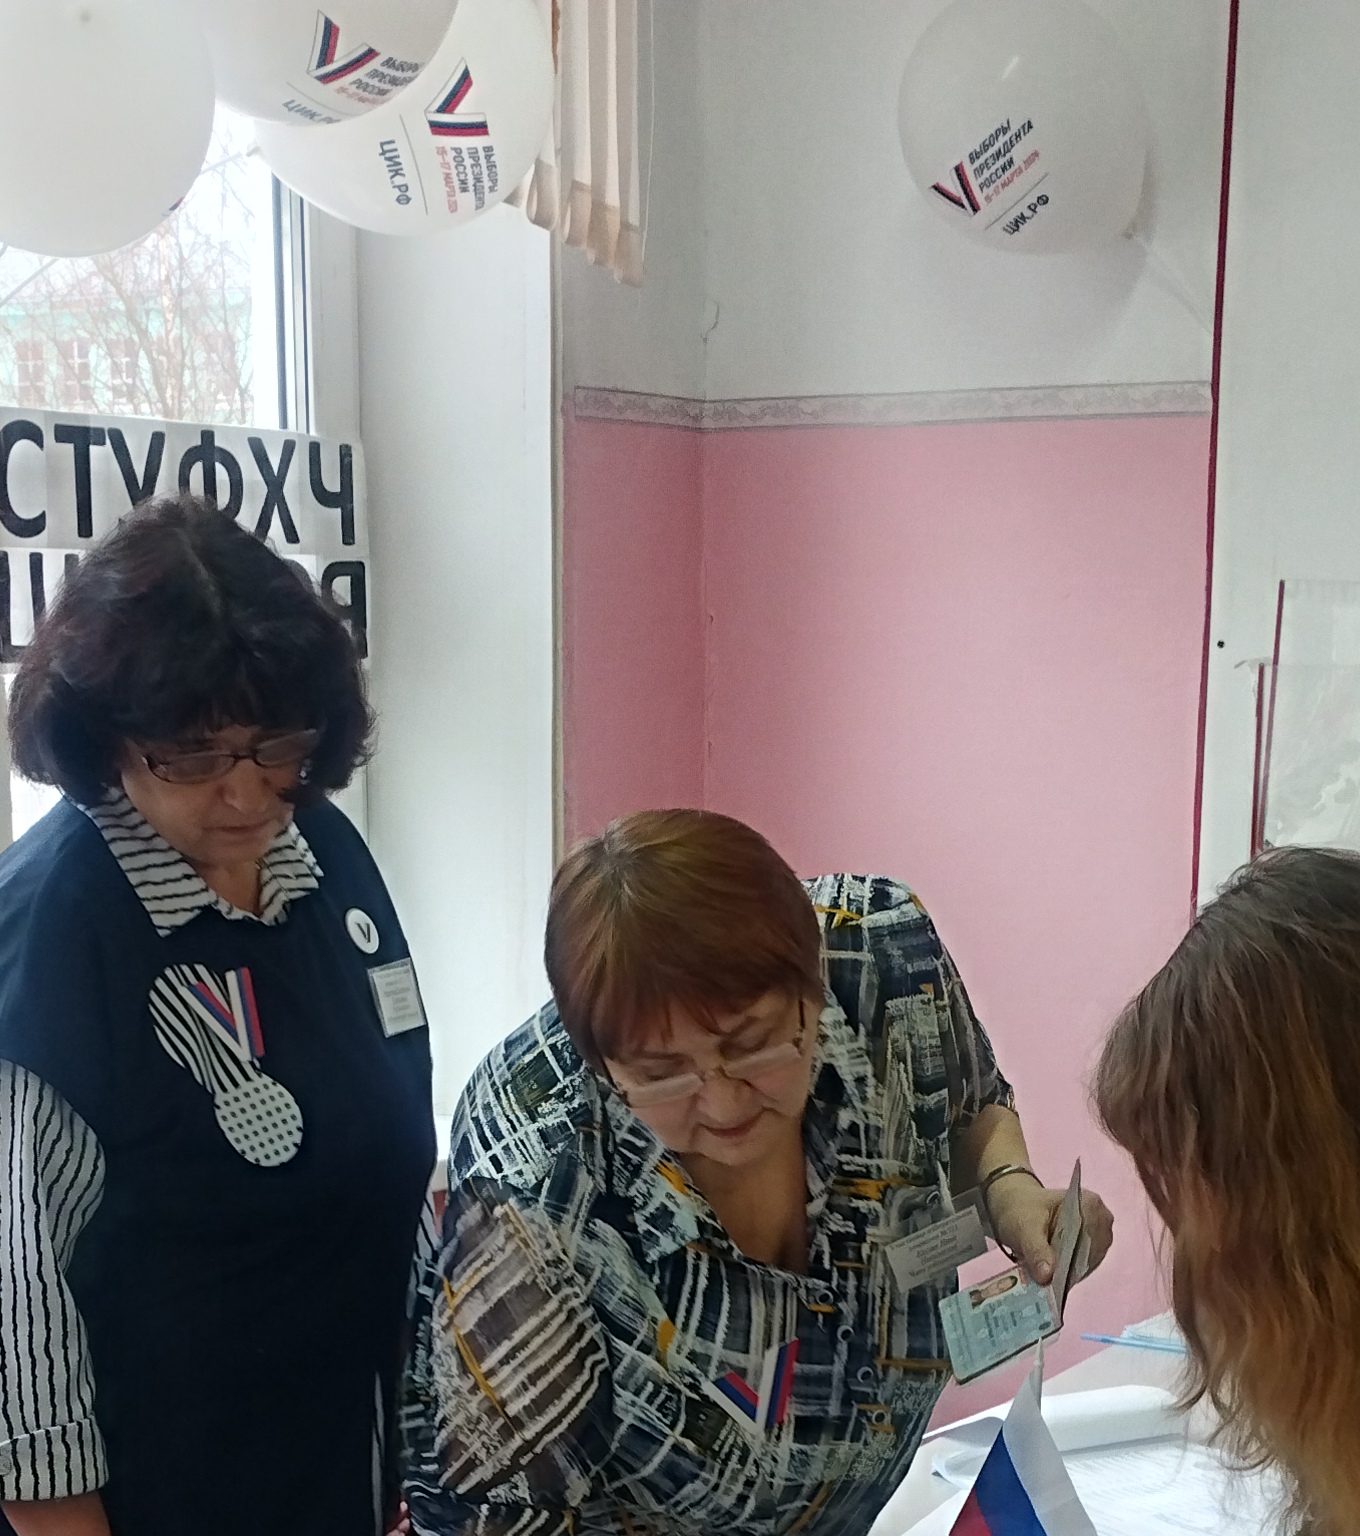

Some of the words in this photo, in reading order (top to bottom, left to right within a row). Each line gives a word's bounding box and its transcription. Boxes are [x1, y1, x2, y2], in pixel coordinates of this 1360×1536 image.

[968, 118, 1012, 165] ВЫБОРЫ
[973, 118, 1034, 180] ПРЕЗИДЕНТА
[378, 138, 412, 206] ЦИК.РФ
[450, 146, 470, 194] РОССИИ
[482, 145, 499, 194] ВЫБОРЫ
[978, 156, 1014, 193] РОССИИ
[1003, 194, 1049, 235] ЦИК.РФ
